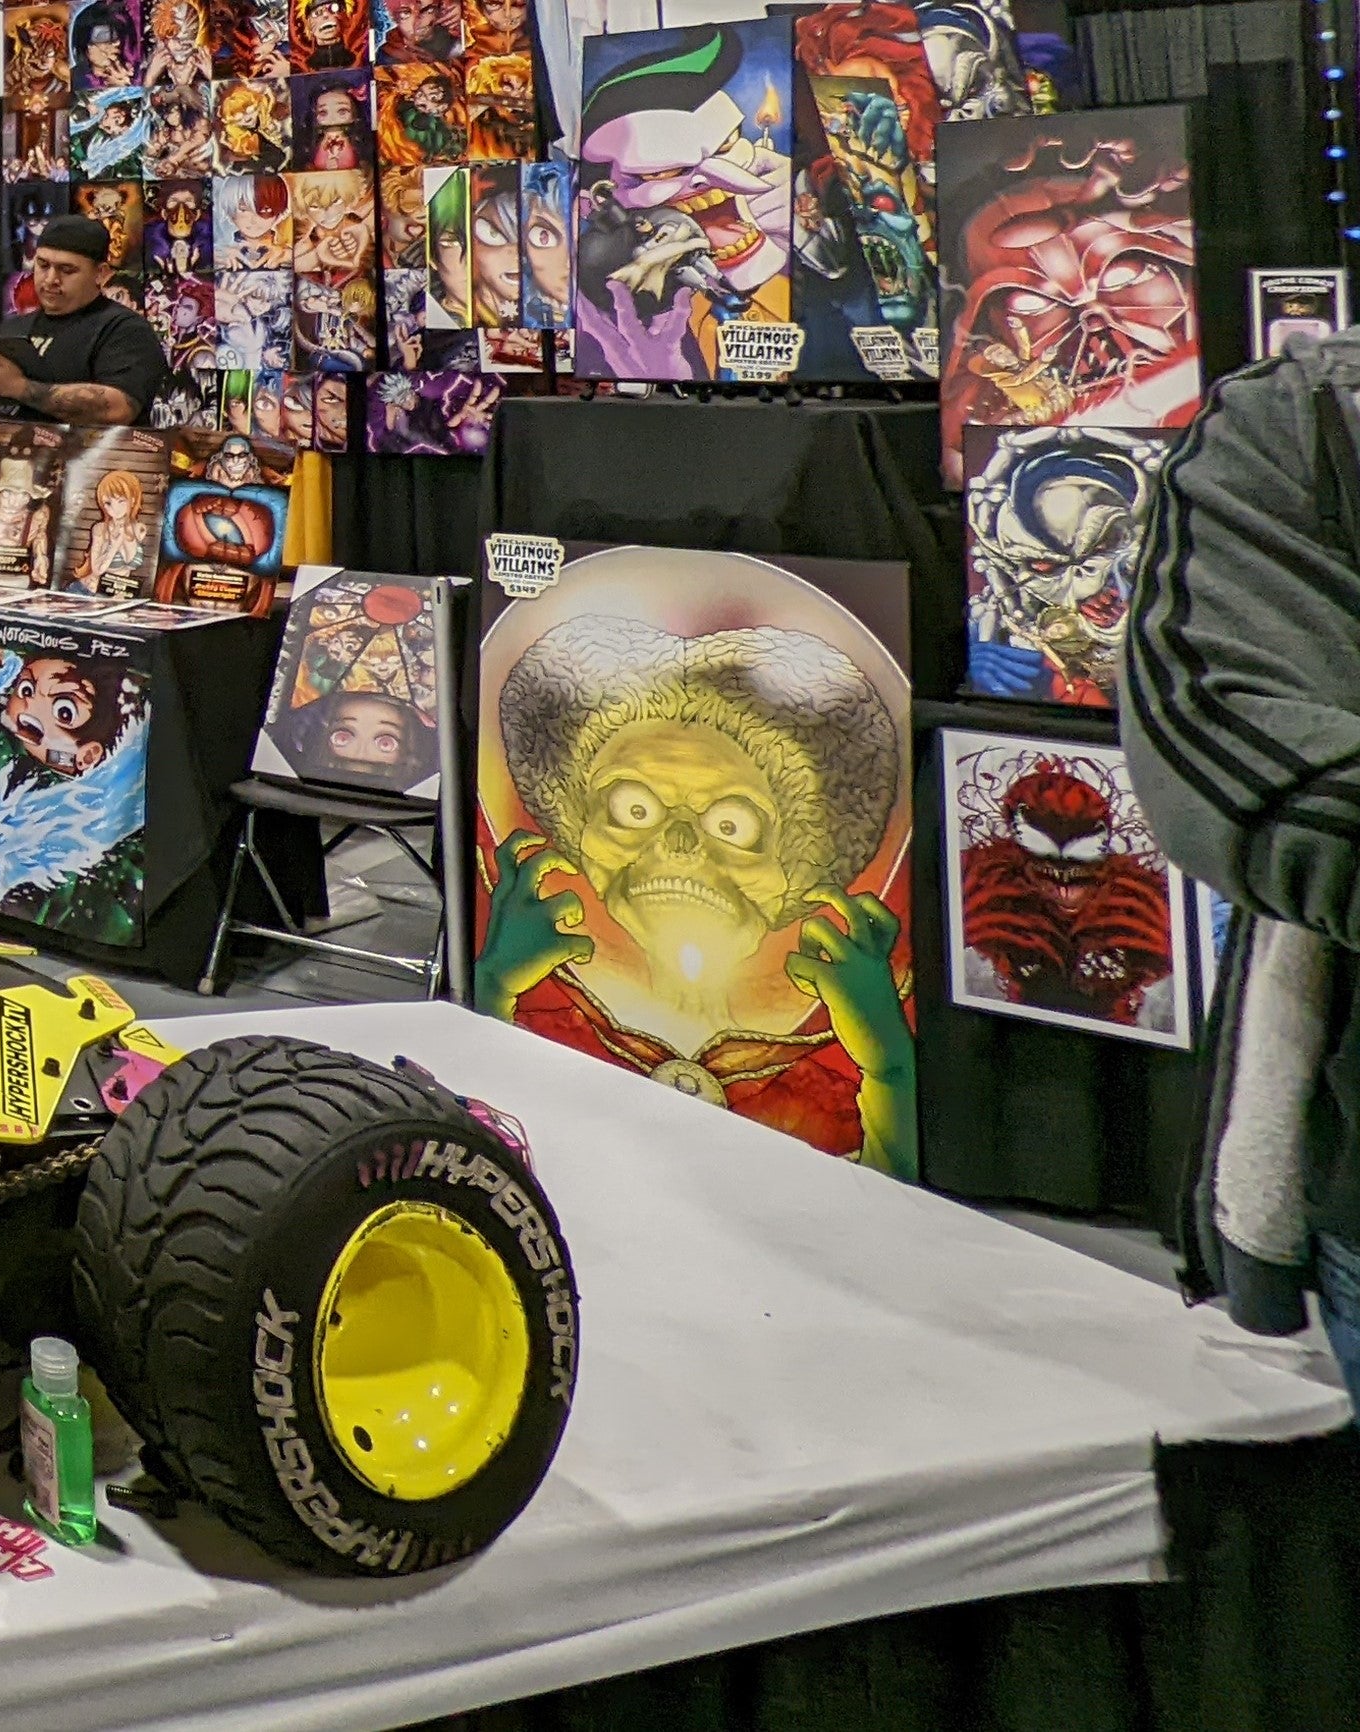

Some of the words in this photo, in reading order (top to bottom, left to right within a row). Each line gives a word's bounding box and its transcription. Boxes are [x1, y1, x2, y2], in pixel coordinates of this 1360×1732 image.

[721, 330, 799, 346] VILLAINOUS
[725, 344, 793, 361] VILLAINS
[741, 371, 772, 380] $199
[490, 543, 560, 561] VILLAINOUS
[494, 557, 555, 576] VILLAINS
[416, 1139, 579, 1403] HYPERSHOCK
[252, 1288, 413, 1571] HYPERSHOCK
